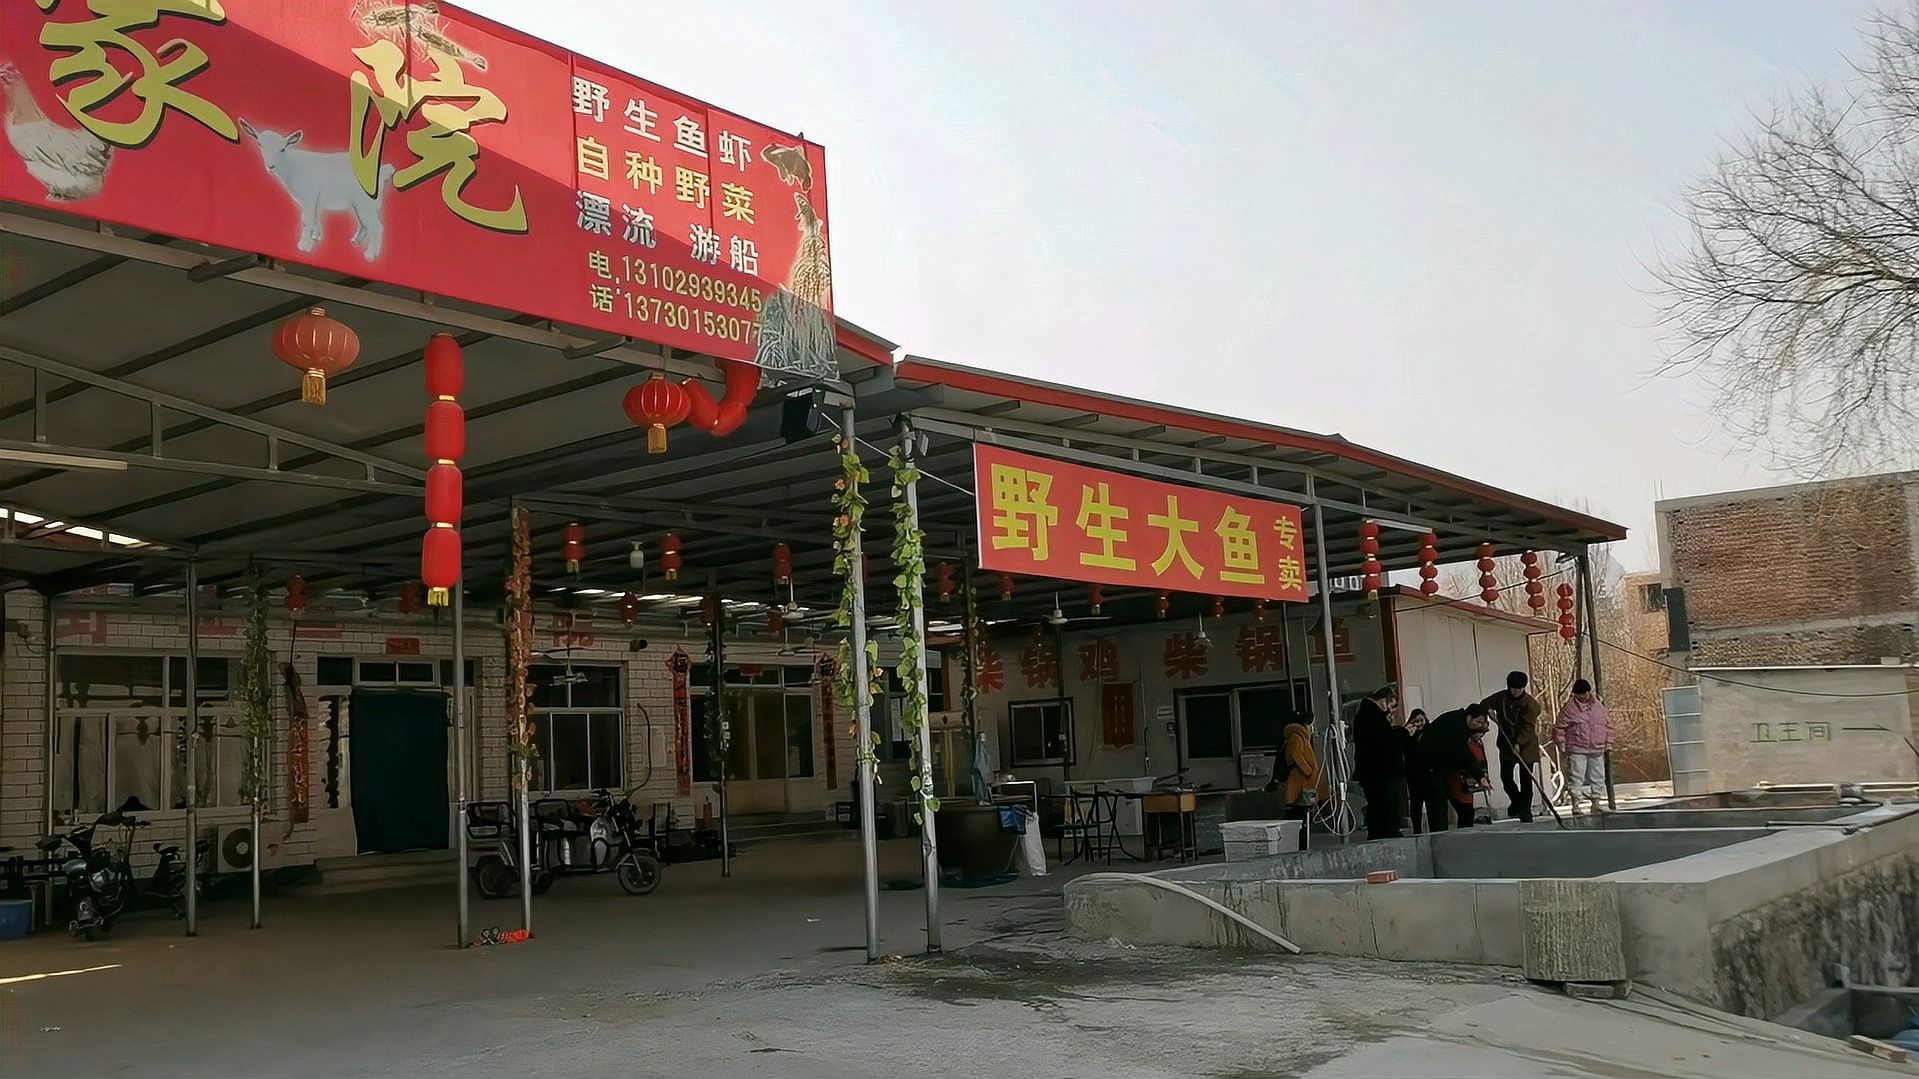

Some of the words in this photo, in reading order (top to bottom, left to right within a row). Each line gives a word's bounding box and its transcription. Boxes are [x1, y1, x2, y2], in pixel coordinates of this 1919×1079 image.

[572, 76, 752, 172] 野生鱼虾
[577, 136, 755, 225] 自种野菜
[576, 189, 656, 249] 漂流
[688, 222, 759, 277] 游船
[621, 255, 763, 313] 13102939345
[623, 292, 762, 347] 13730153077
[990, 463, 1266, 582] 野生大鱼
[1273, 515, 1303, 593] 专卖
